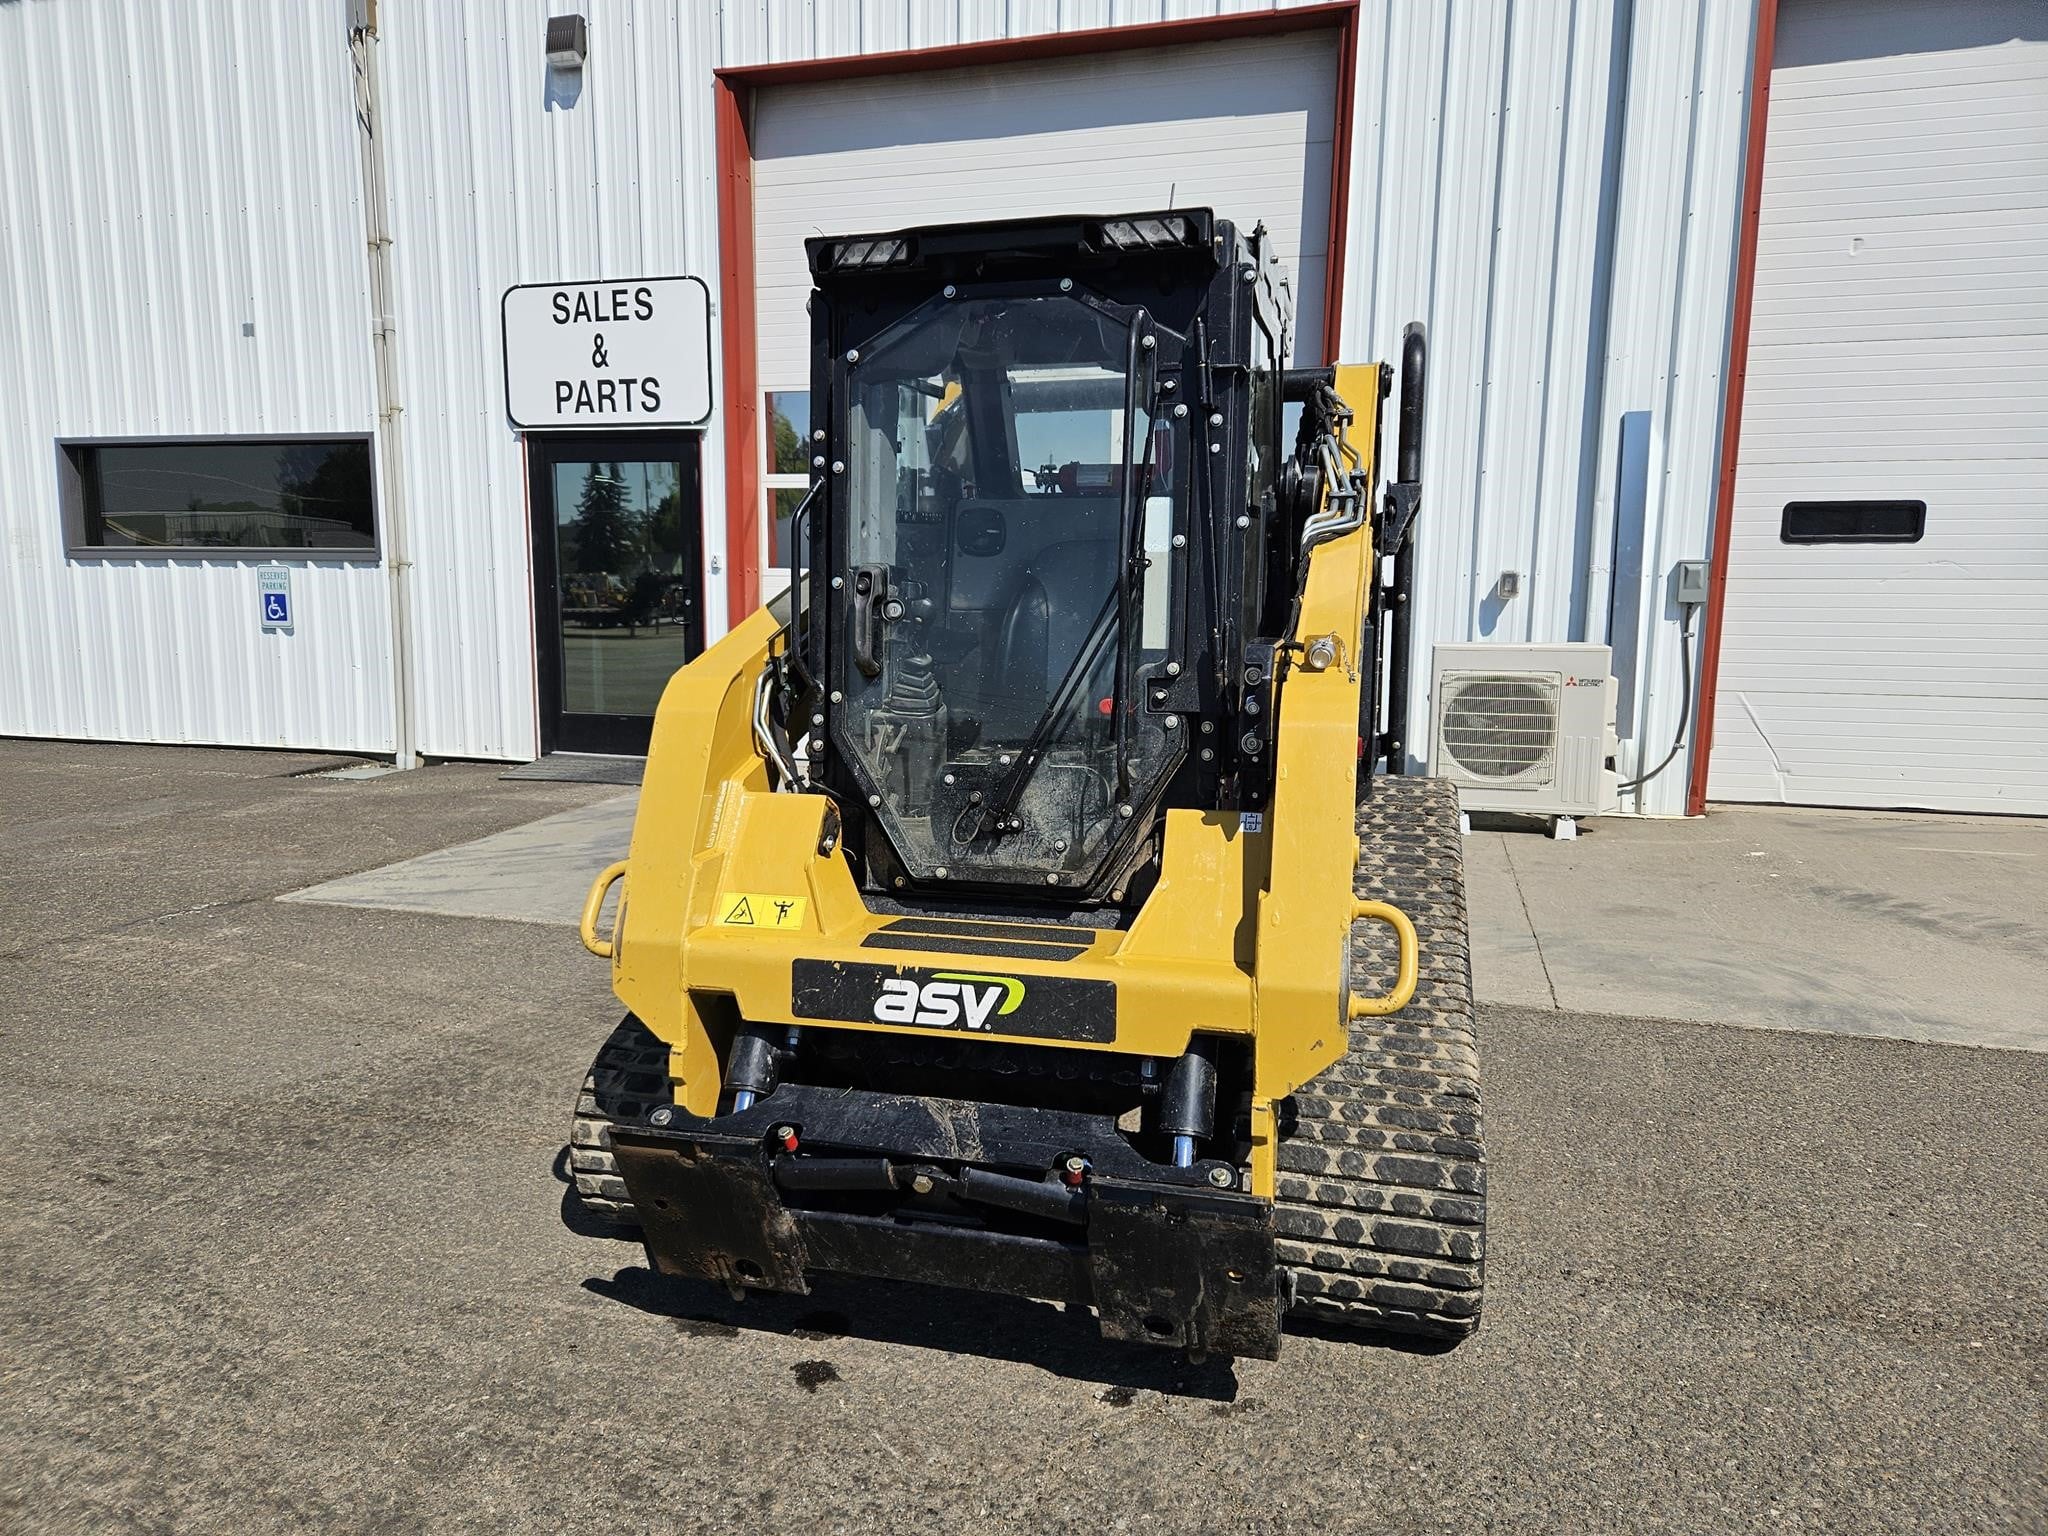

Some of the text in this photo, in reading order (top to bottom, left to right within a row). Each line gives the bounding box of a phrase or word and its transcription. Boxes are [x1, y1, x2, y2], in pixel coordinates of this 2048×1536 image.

[552, 287, 653, 325] SALES
[591, 333, 610, 368] &
[555, 377, 661, 414] PARTS
[262, 581, 287, 590] PARKING
